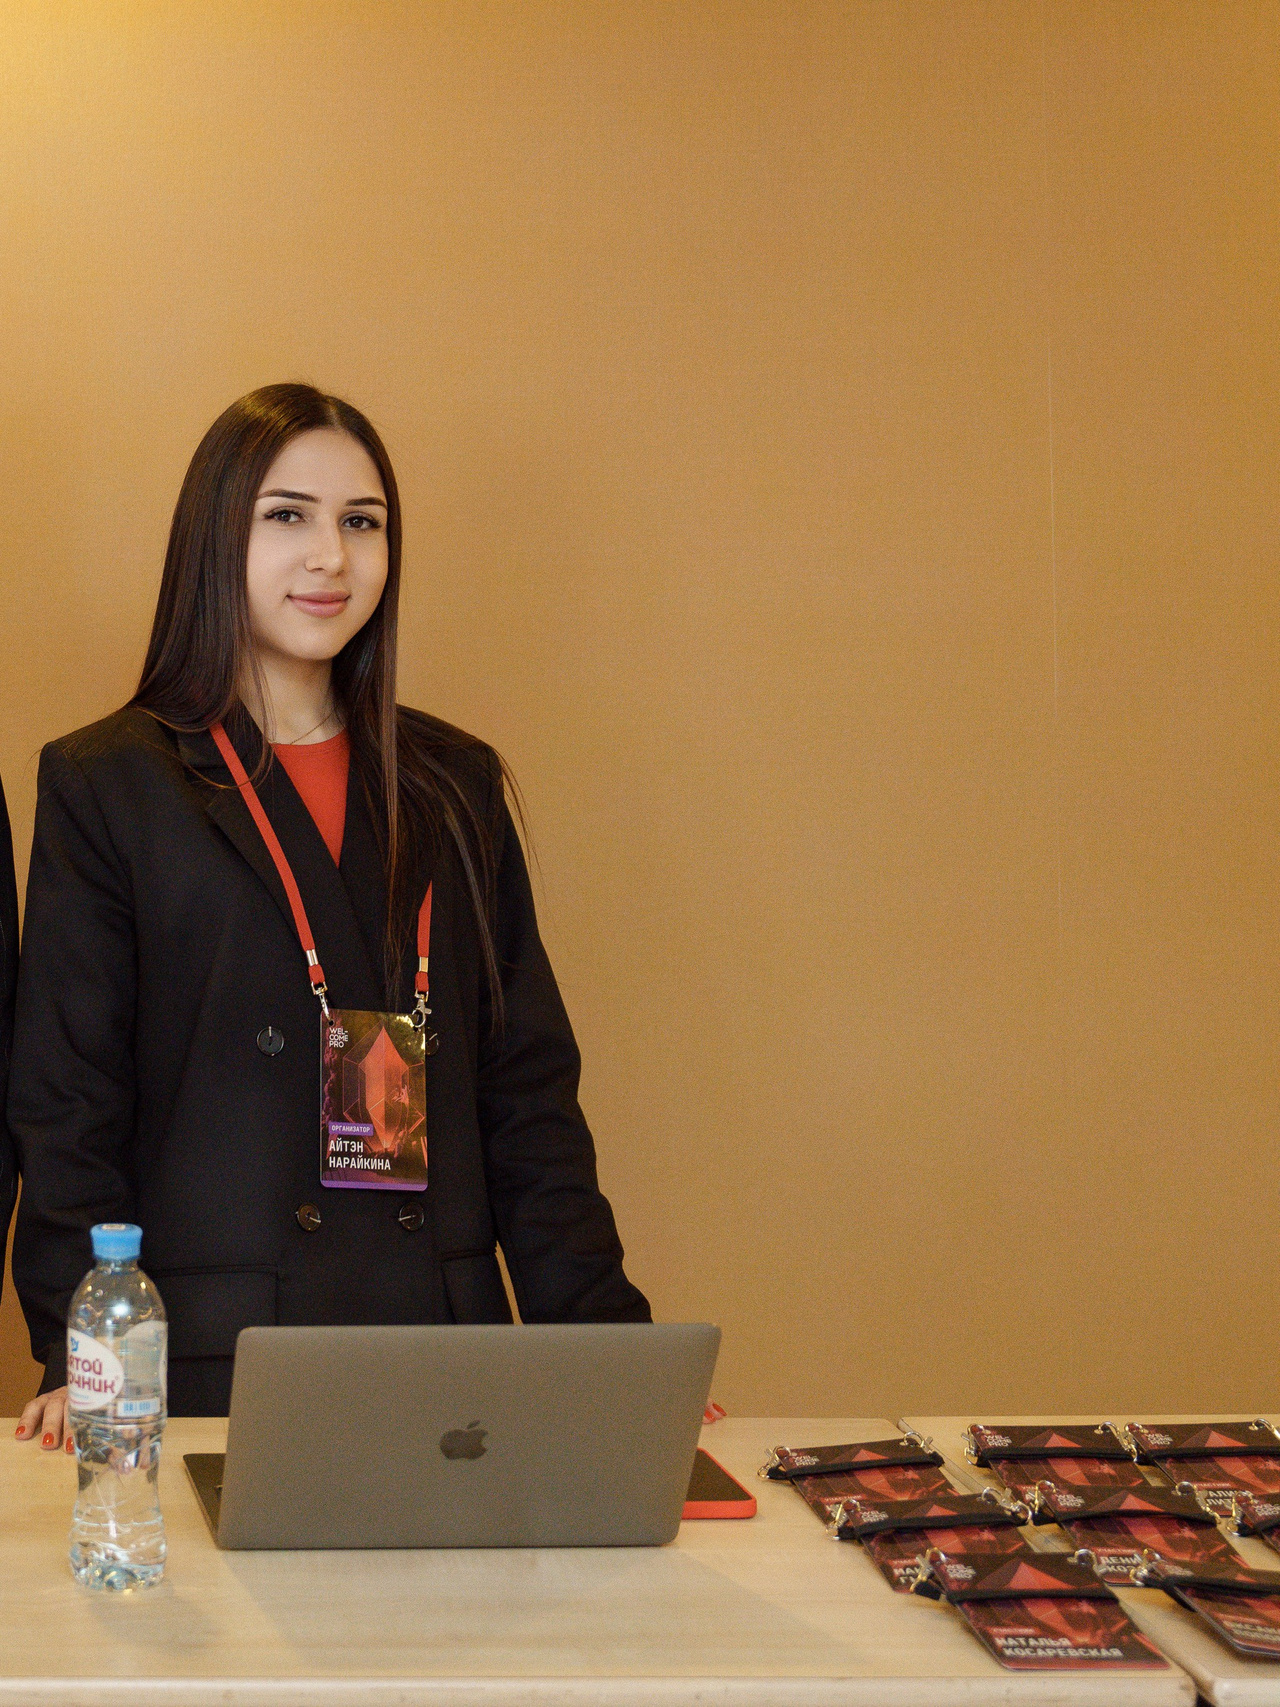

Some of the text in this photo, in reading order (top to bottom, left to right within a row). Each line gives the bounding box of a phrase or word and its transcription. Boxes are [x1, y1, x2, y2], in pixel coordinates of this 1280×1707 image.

[329, 1027, 348, 1035] WEL-
[329, 1034, 349, 1042] COME
[329, 1040, 345, 1048] PRO
[331, 1124, 371, 1133] ОРГАНИЗАТОР
[328, 1138, 364, 1154] АЙТЭН
[328, 1154, 391, 1171] НАРАЙКИНА
[994, 1636, 1071, 1648] НАТАЛЬЯ
[1002, 1647, 1123, 1658] КОСАРЕВСКАЯ
